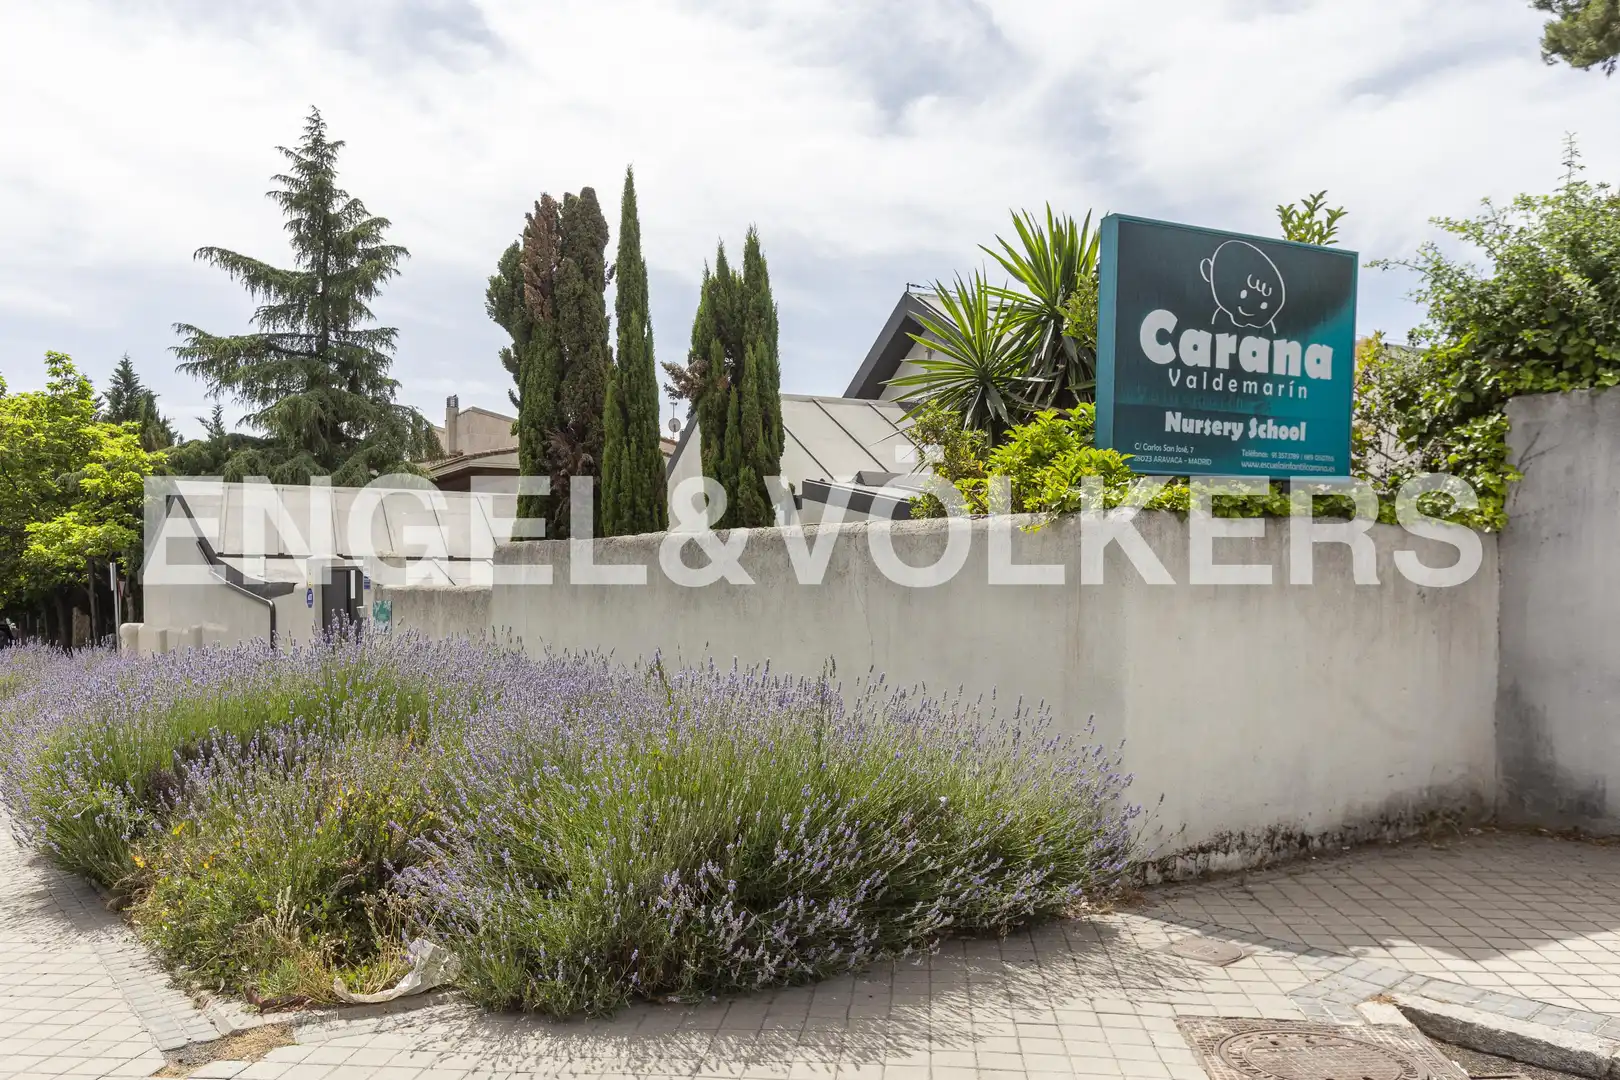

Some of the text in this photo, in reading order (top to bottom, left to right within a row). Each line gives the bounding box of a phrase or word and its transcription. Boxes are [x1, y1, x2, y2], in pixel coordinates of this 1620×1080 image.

[1139, 309, 1334, 380] Carana
[1168, 368, 1308, 399] Valdemarín
[1164, 411, 1307, 441] Nursery School
[1142, 443, 1162, 452] Carlos
[1163, 444, 1175, 453] San
[1189, 446, 1195, 454] 7
[1153, 456, 1183, 464] ARAVACA
[1188, 458, 1212, 466] MADRID
